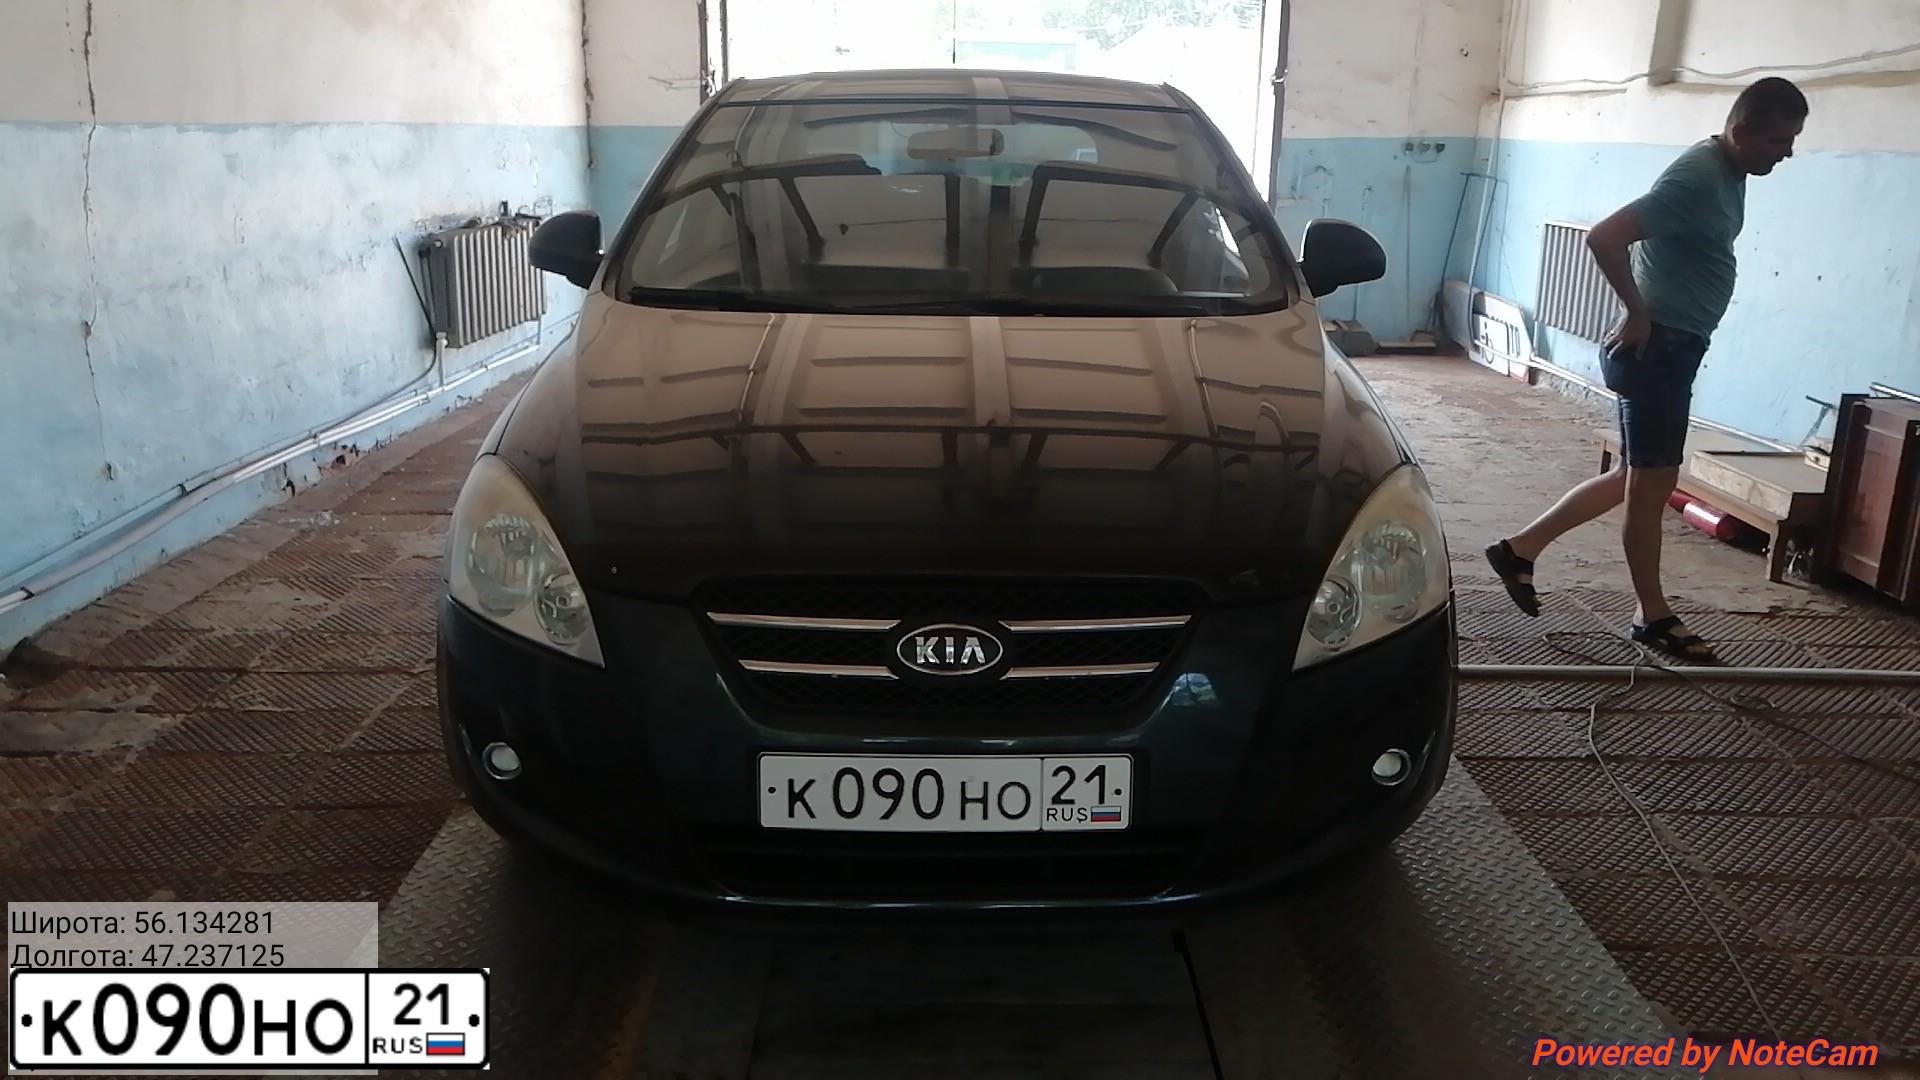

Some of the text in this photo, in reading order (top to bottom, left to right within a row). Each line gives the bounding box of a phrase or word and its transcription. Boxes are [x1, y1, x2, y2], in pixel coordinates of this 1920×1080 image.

[914, 636, 986, 665] KIA
[1051, 764, 1107, 805] 21
[1046, 808, 1088, 823] RUS
